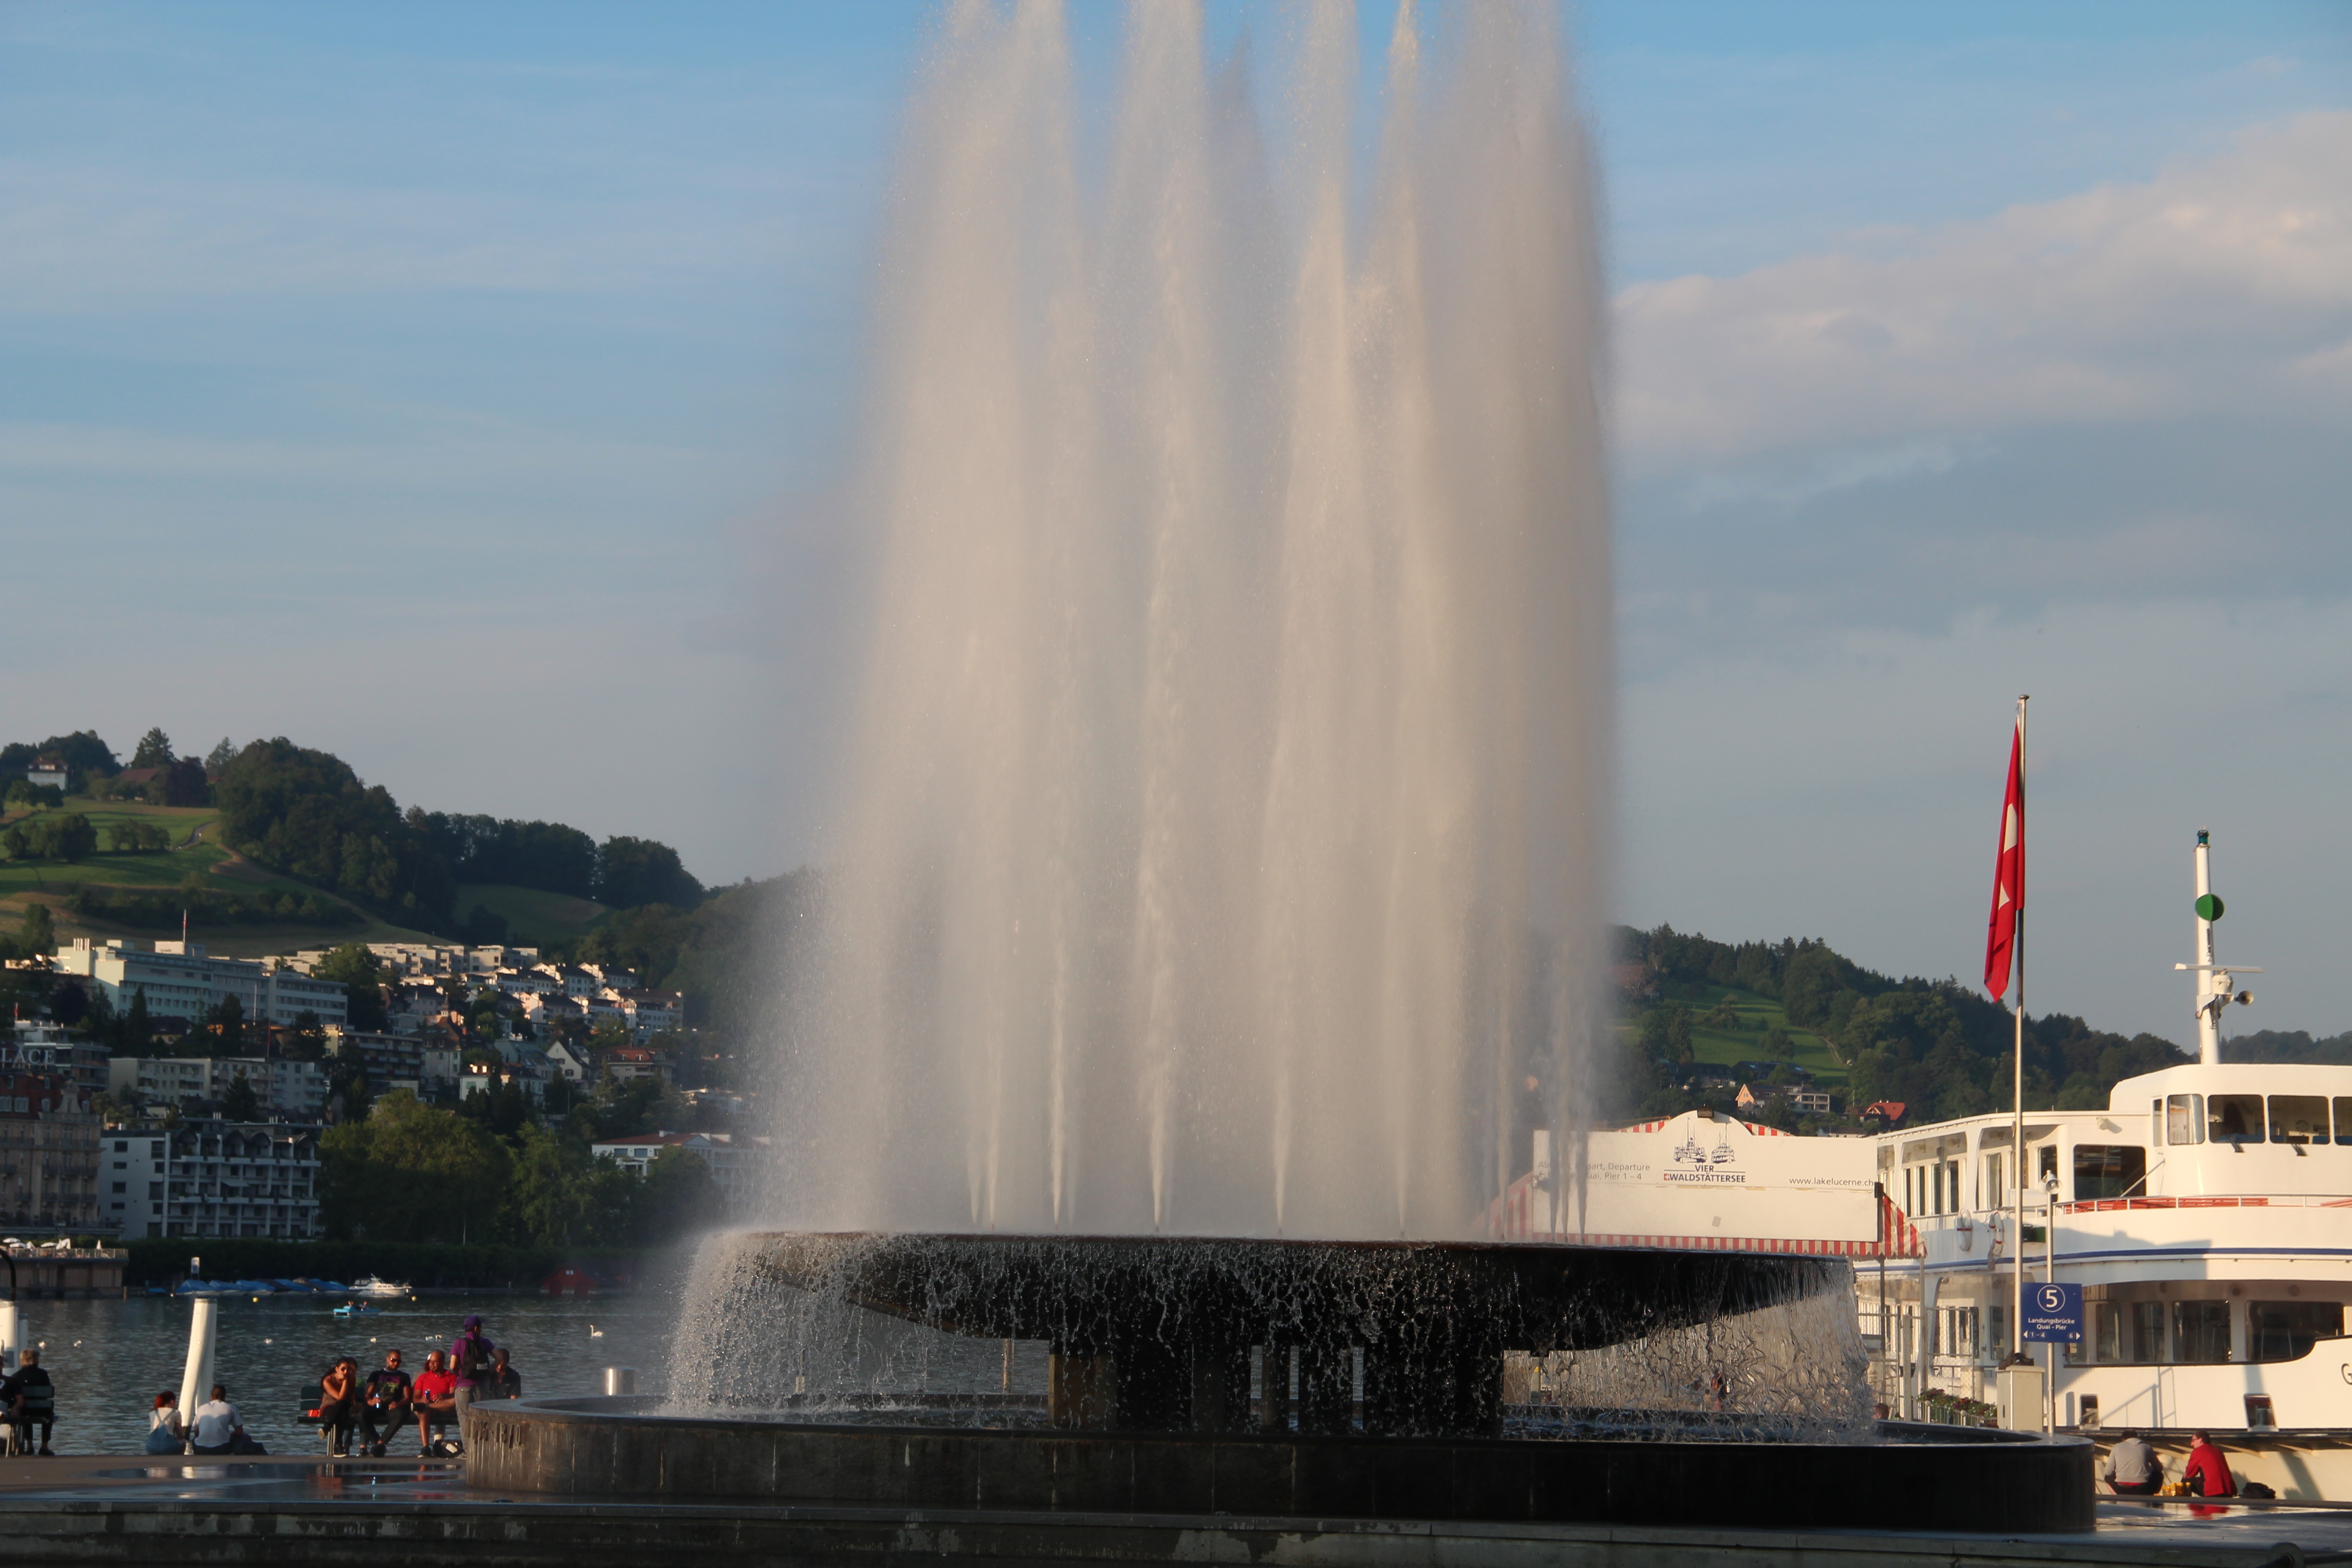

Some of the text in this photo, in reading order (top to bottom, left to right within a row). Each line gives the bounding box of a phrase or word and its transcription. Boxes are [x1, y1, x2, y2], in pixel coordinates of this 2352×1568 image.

[1608, 1163, 1651, 1171] Departure
[1670, 1172, 1746, 1182] WALDSTÄTTERSEE
[1789, 1177, 1873, 1186] www.lakelucerne.ch
[2046, 1289, 2058, 1308] 5
